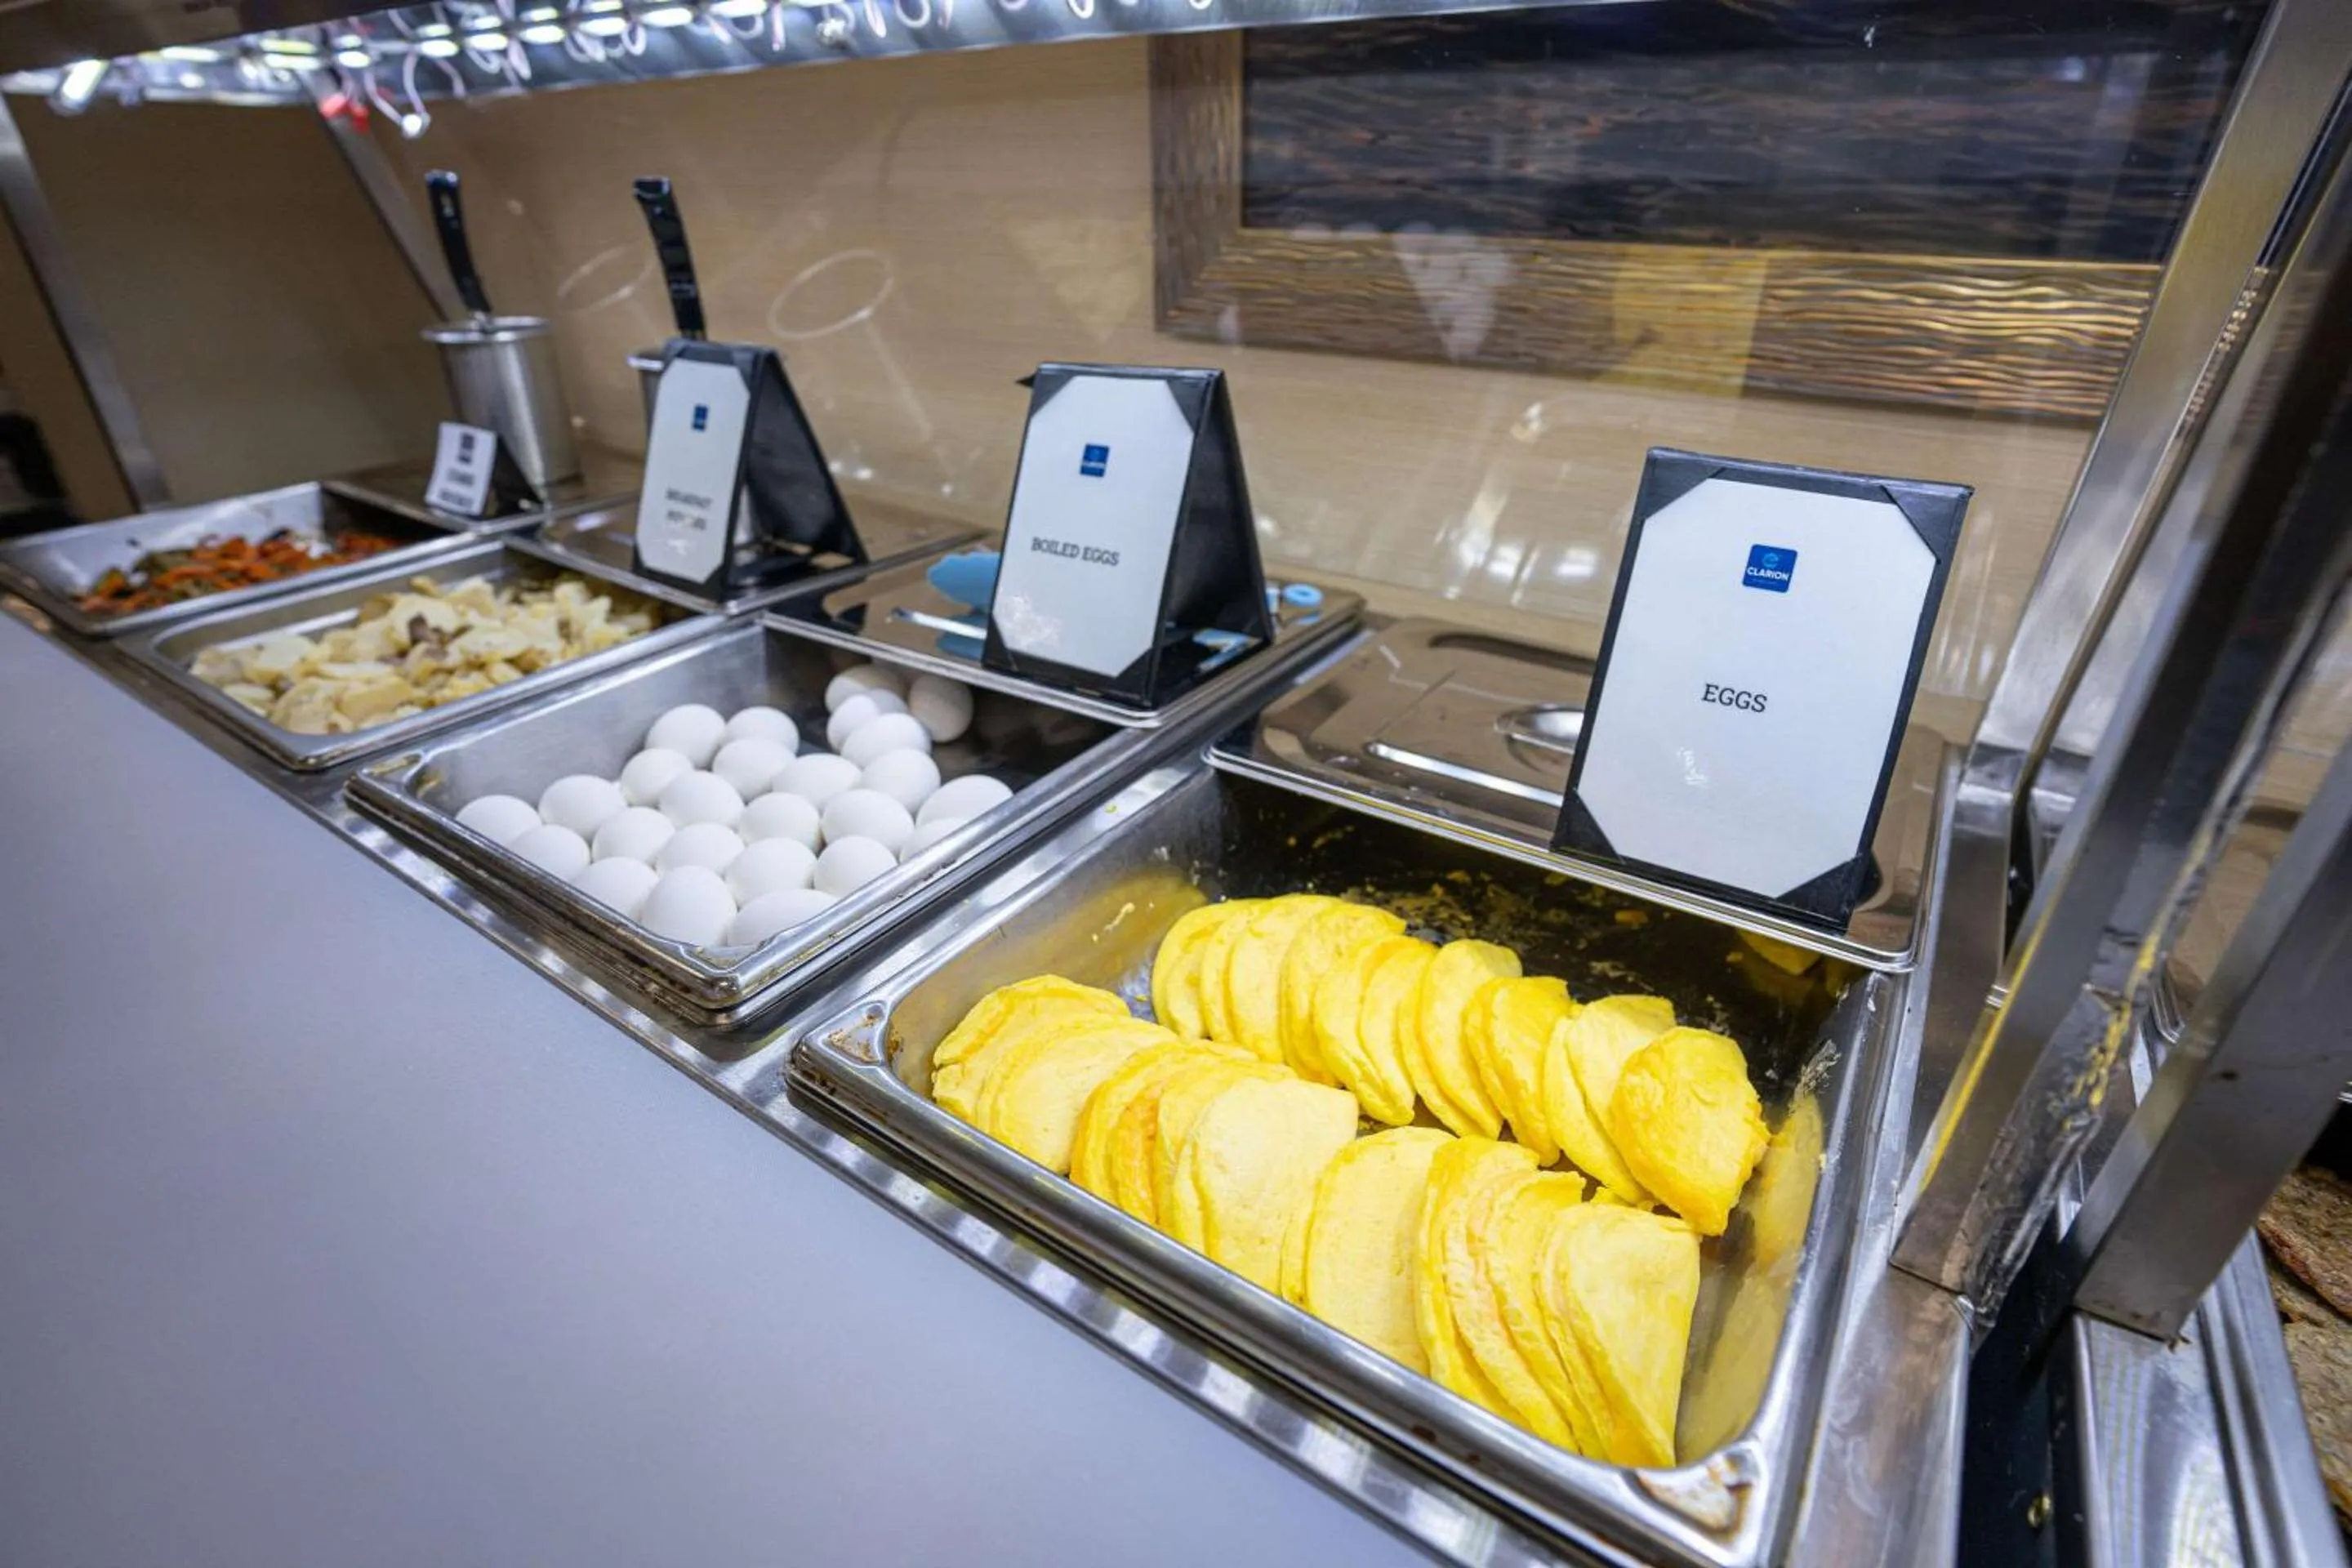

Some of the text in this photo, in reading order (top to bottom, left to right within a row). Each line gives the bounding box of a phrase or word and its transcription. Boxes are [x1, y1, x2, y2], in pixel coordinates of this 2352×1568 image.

[1032, 537, 1120, 566] BOILED EGGS
[1747, 567, 1789, 581] CLARION
[1702, 683, 1767, 712] EGGS
